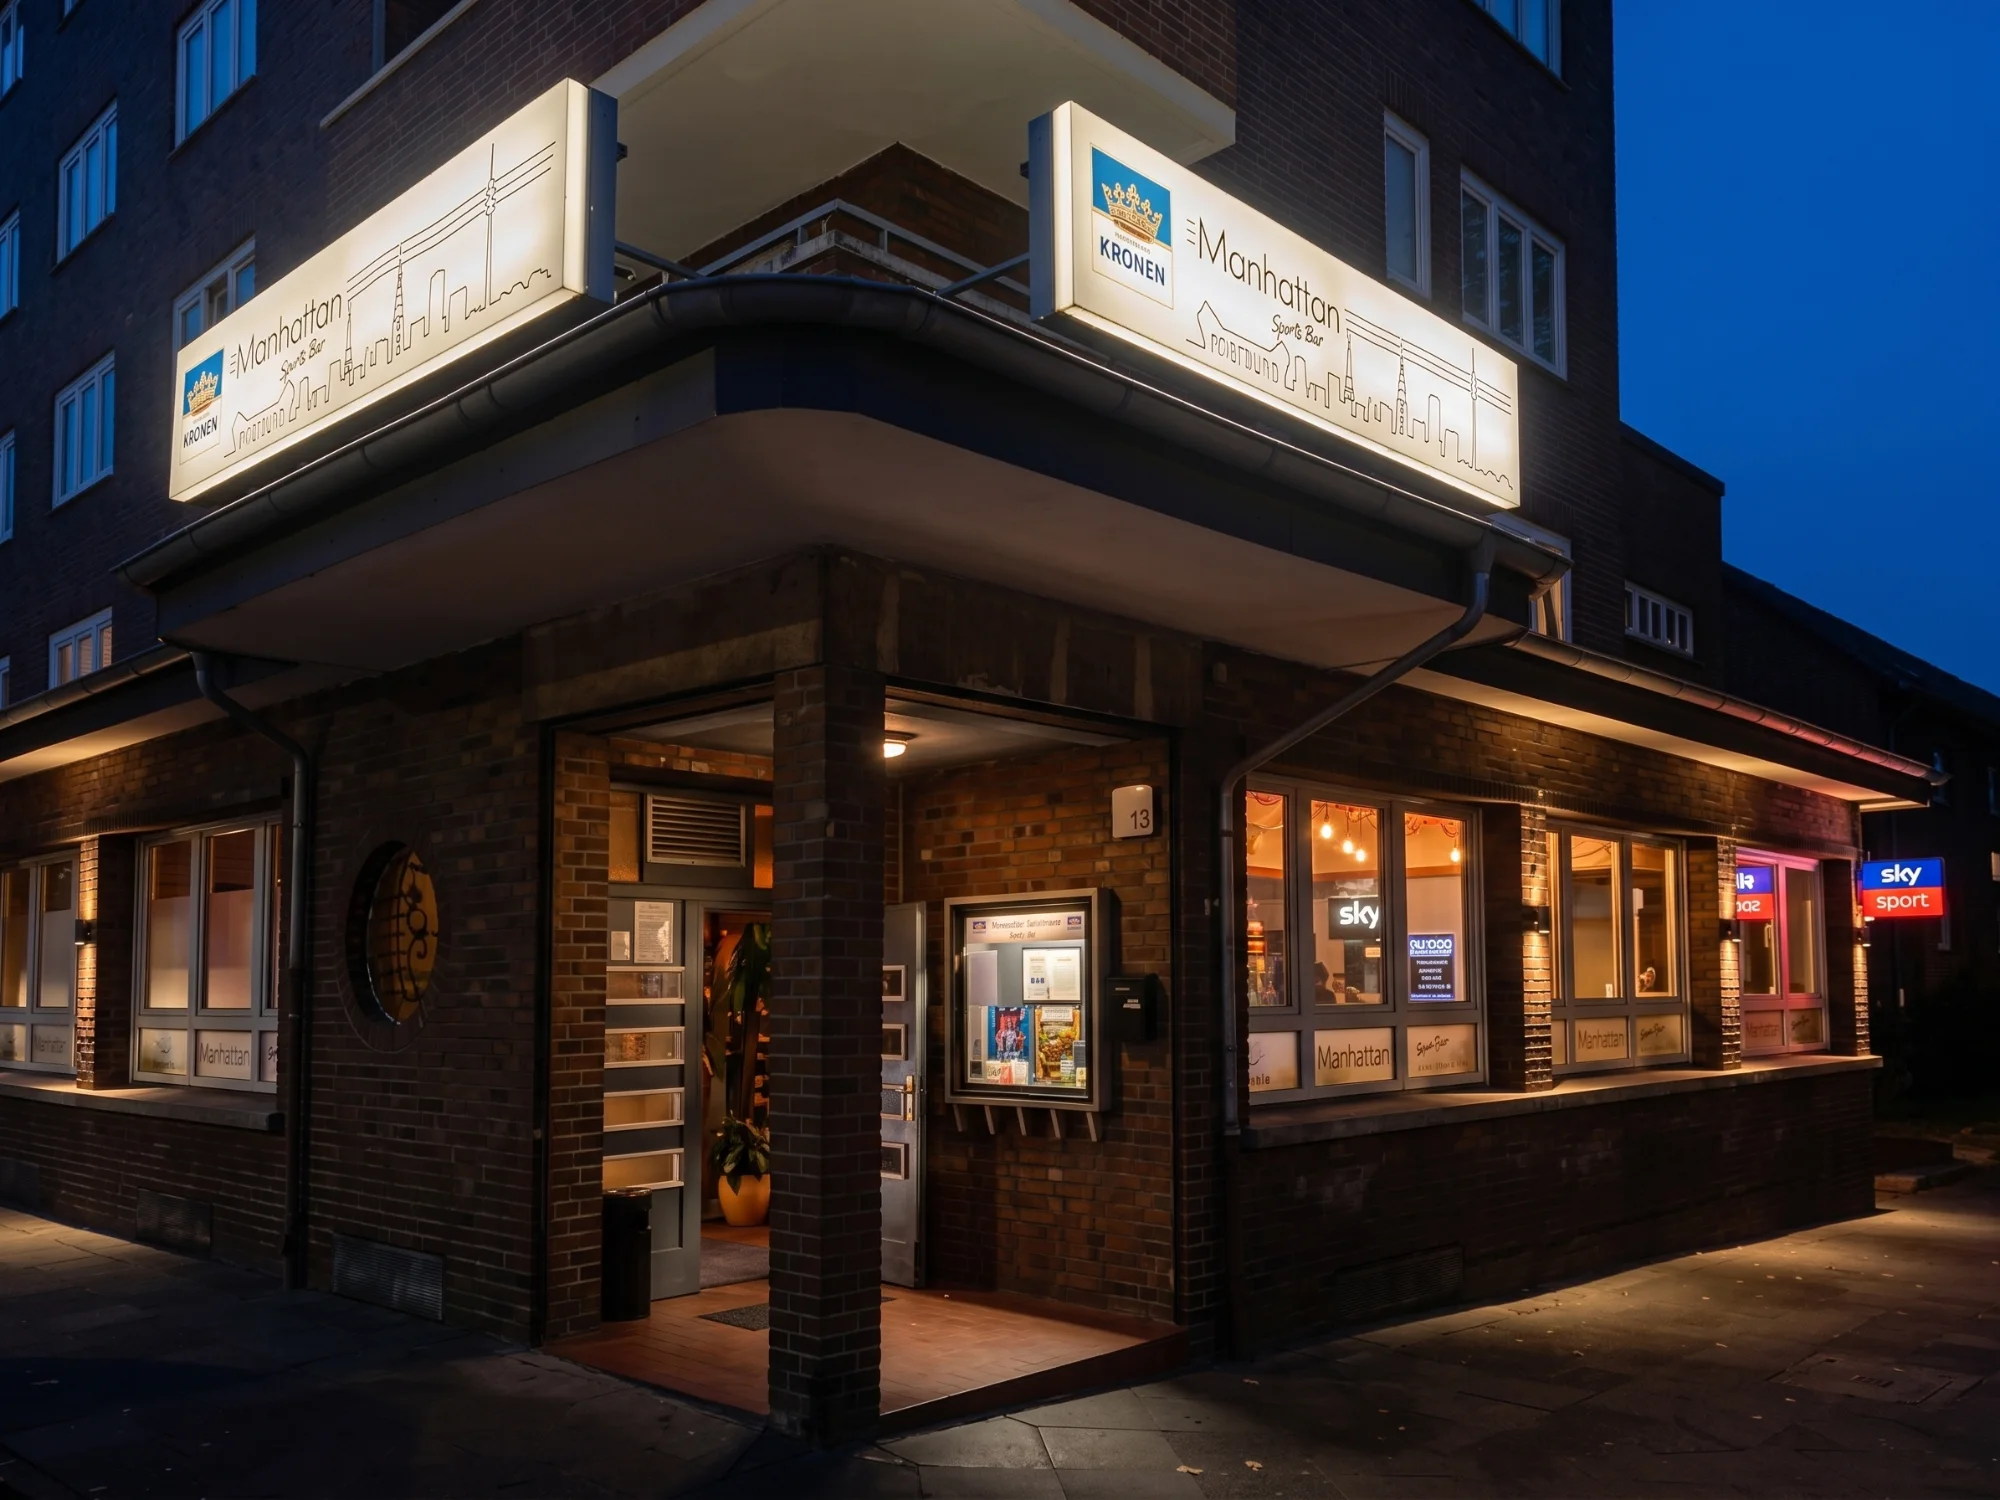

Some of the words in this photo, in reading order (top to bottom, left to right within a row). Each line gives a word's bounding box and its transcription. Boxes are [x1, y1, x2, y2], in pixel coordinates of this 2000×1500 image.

[1100, 235, 1165, 286] KRONEN
[1199, 216, 1340, 333] Manhattan
[236, 294, 342, 379] Manhattan
[1271, 314, 1302, 341] Sports
[1305, 325, 1324, 347] Bar
[308, 338, 325, 360] Bar
[183, 415, 217, 449] KRONEN
[1130, 808, 1150, 830] 13
[1881, 864, 1922, 886] sky
[1340, 900, 1379, 929] sky
[1876, 892, 1930, 912] sport
[1578, 1029, 1625, 1050] Manhattan
[200, 1042, 250, 1067] Manhattan
[1317, 1044, 1390, 1070] Manhattan
